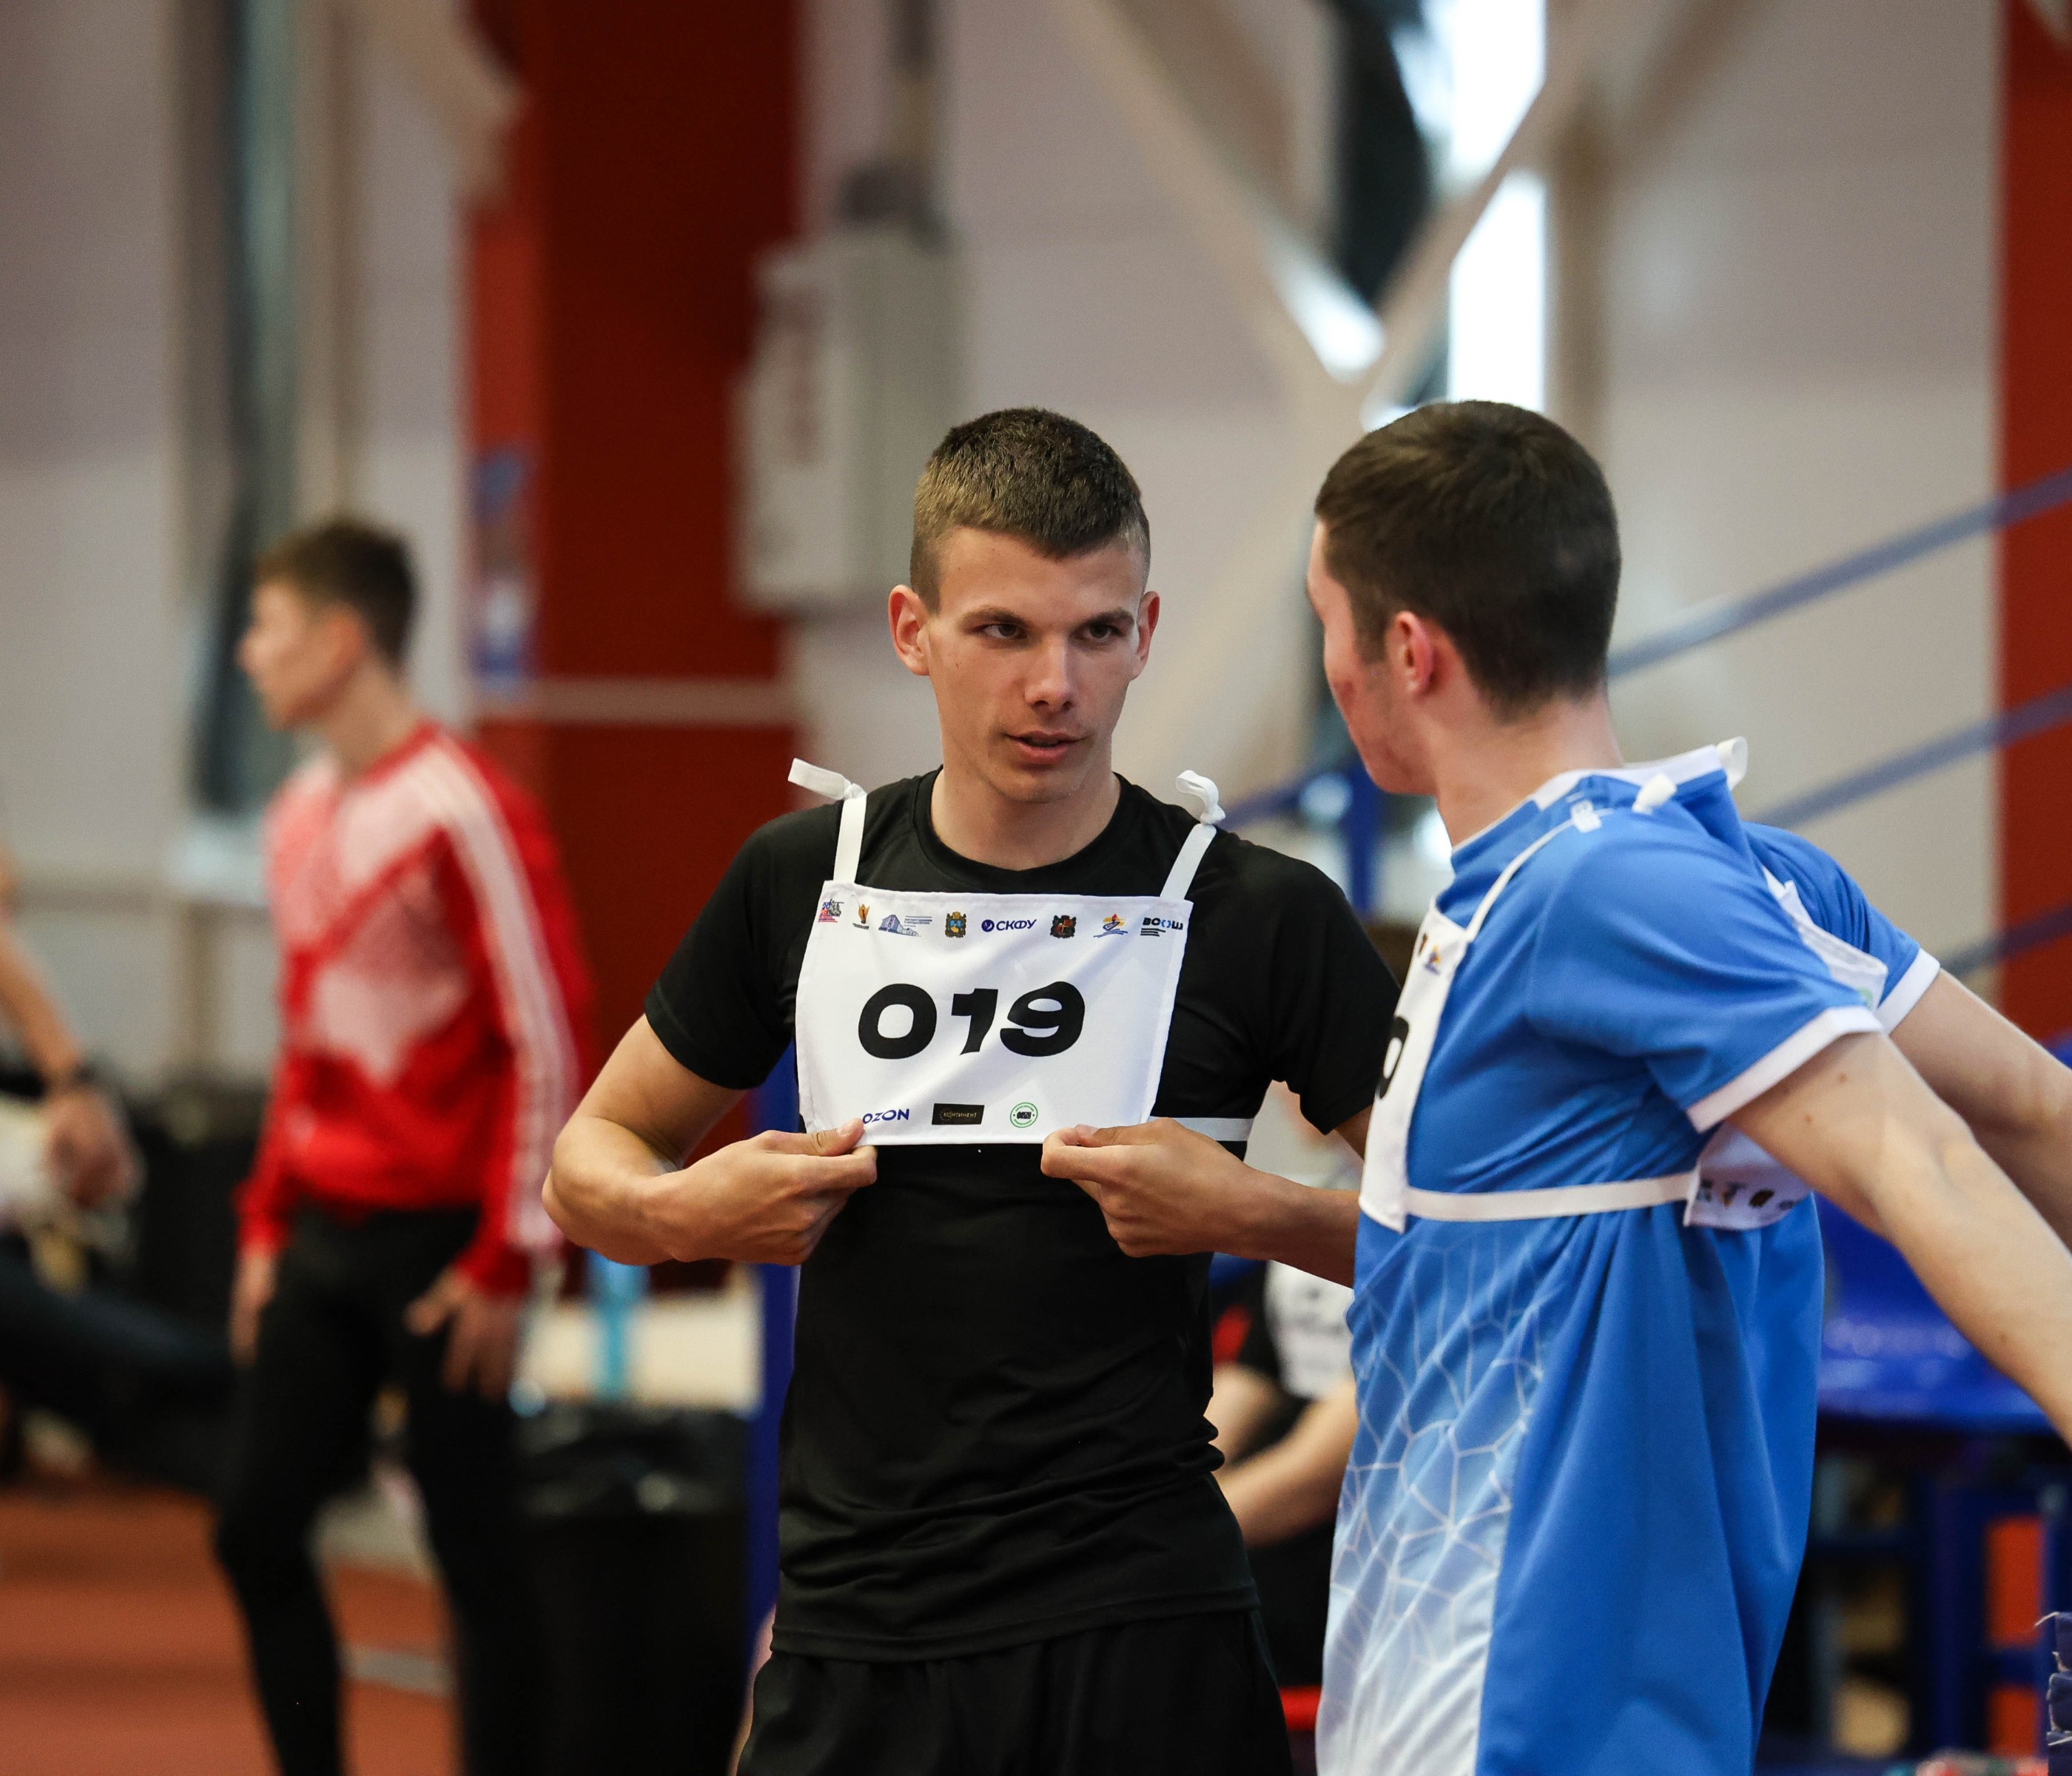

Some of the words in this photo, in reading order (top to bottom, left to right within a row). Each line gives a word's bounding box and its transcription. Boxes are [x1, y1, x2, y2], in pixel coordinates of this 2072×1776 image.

[996, 919, 1037, 931] СКФУ
[858, 980, 1086, 1059] 019
[862, 1109, 909, 1124] OZON
